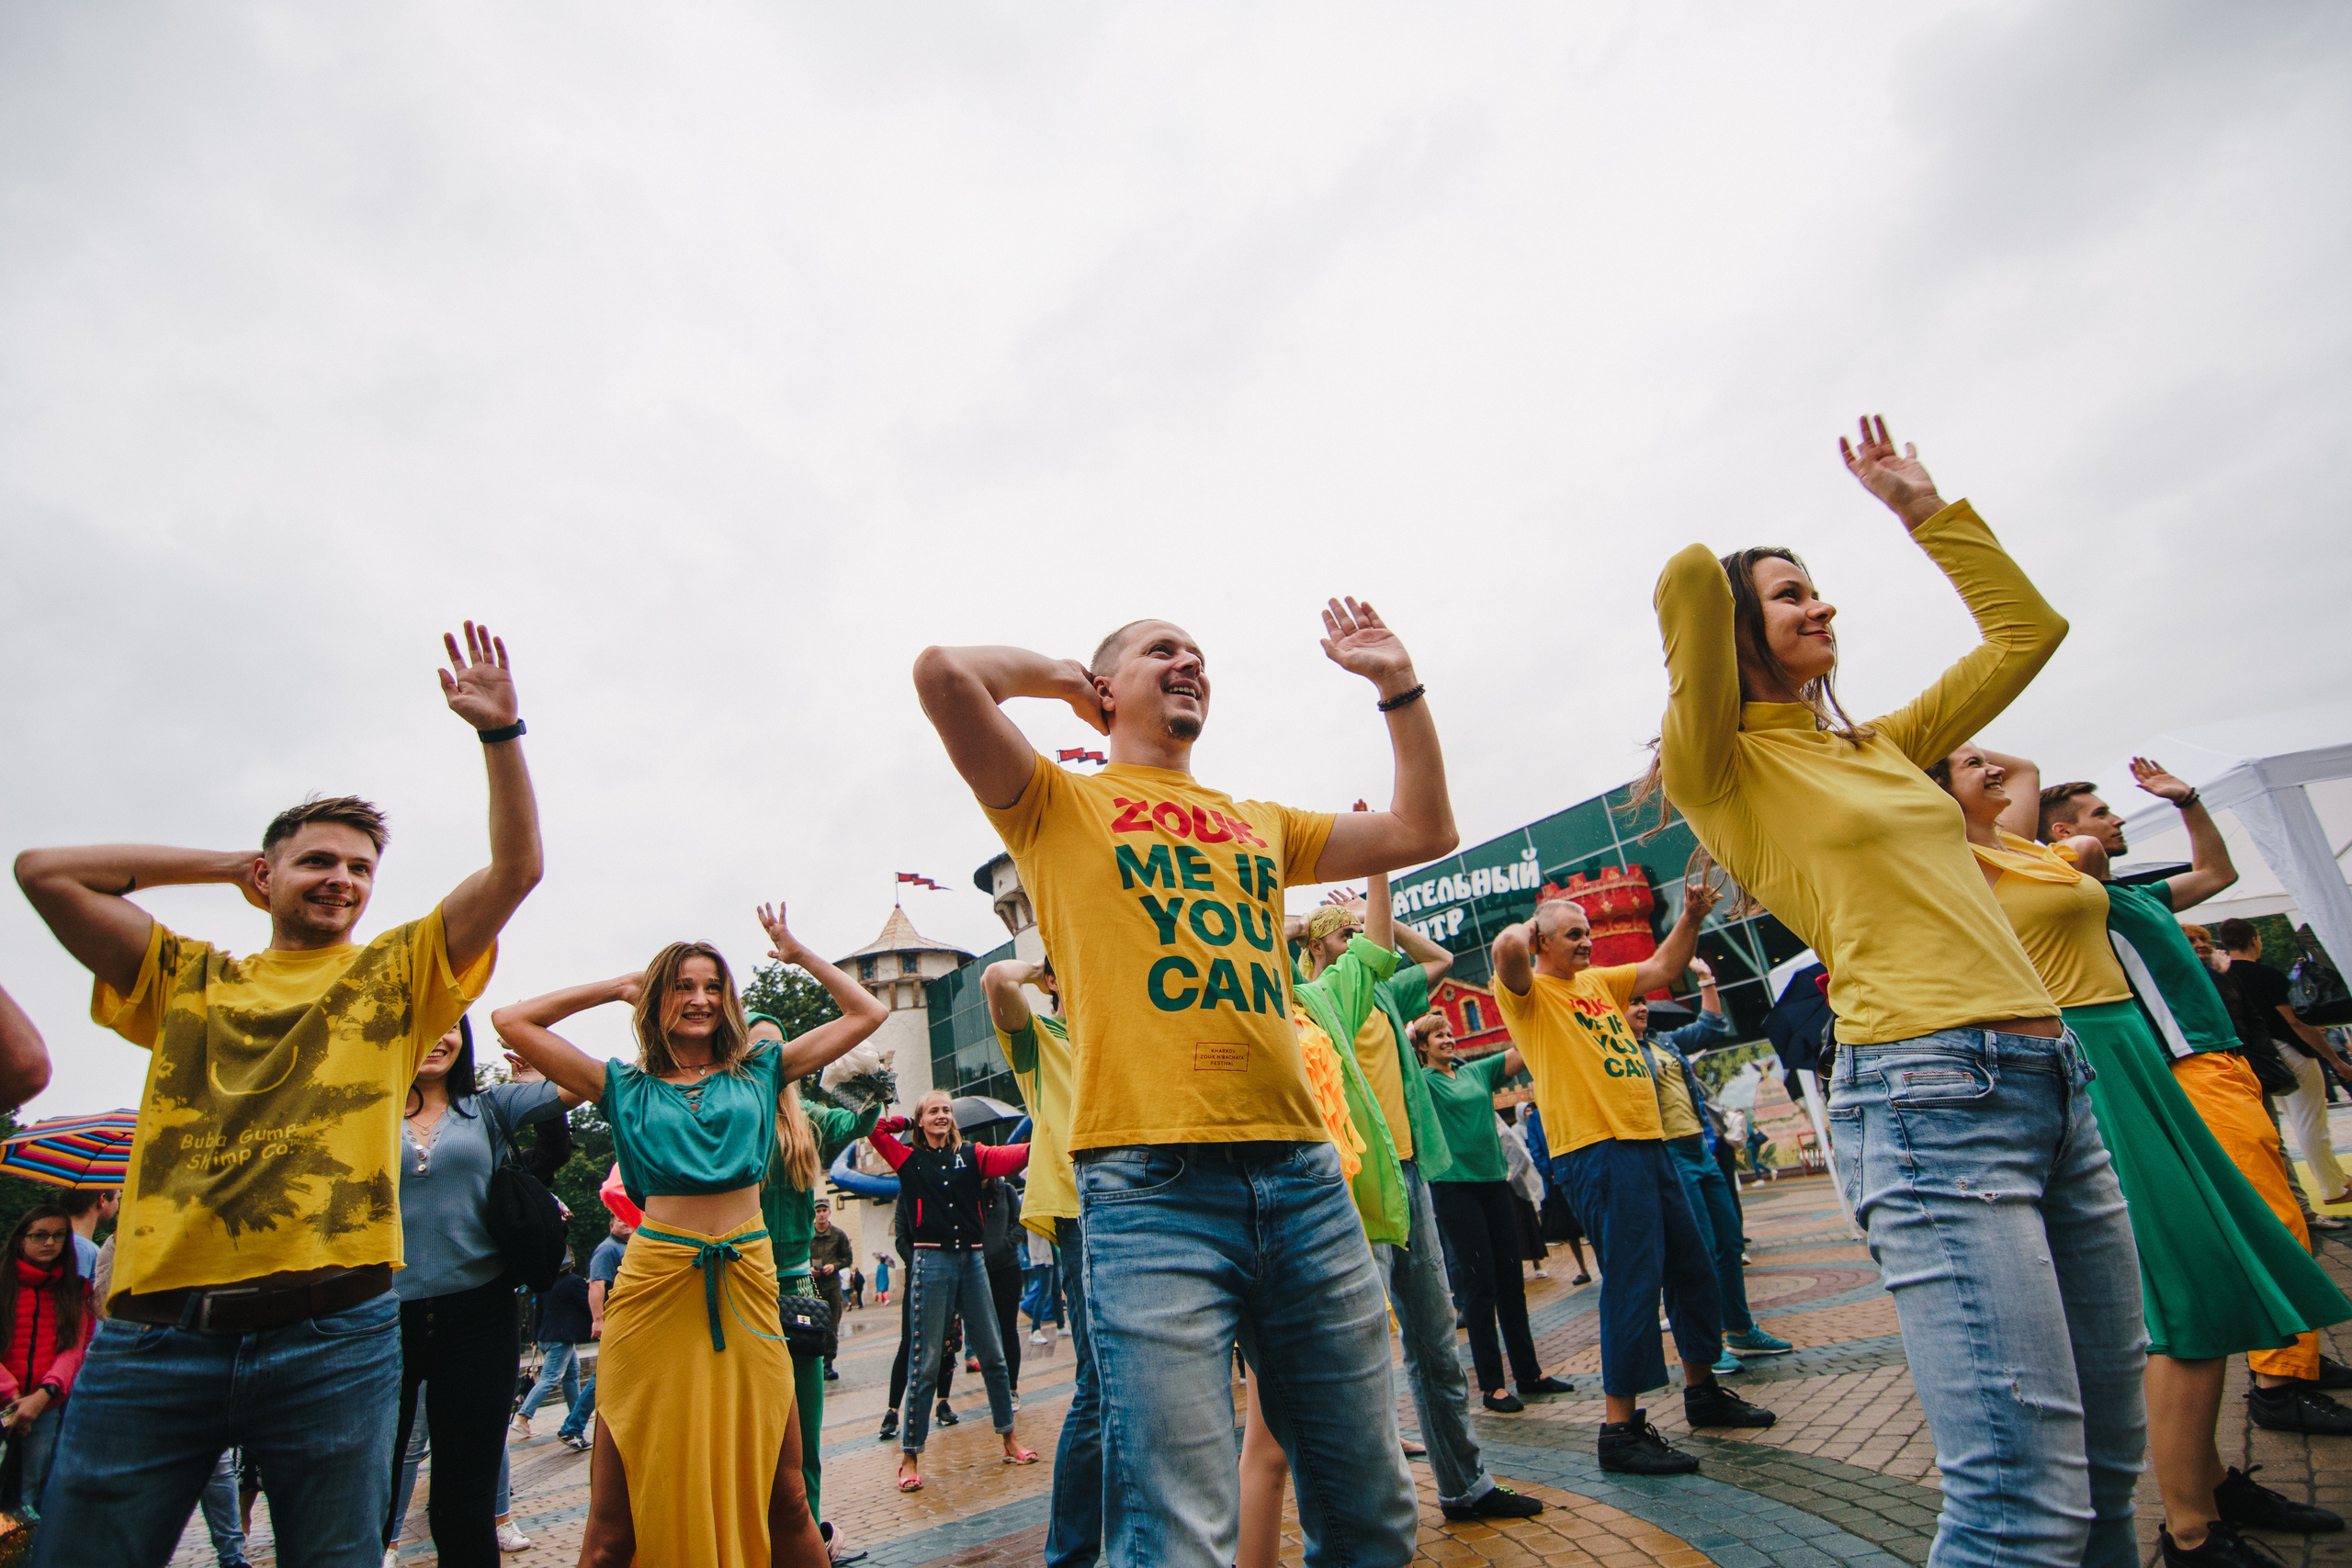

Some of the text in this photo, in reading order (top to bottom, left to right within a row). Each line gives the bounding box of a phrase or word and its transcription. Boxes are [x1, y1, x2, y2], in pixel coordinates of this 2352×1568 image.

[1110, 797, 1269, 848] ZOUK
[1114, 843, 1278, 903] ME IF
[1139, 896, 1275, 953] YOU
[1396, 908, 1464, 953] НТР
[1148, 955, 1285, 1020] CAN
